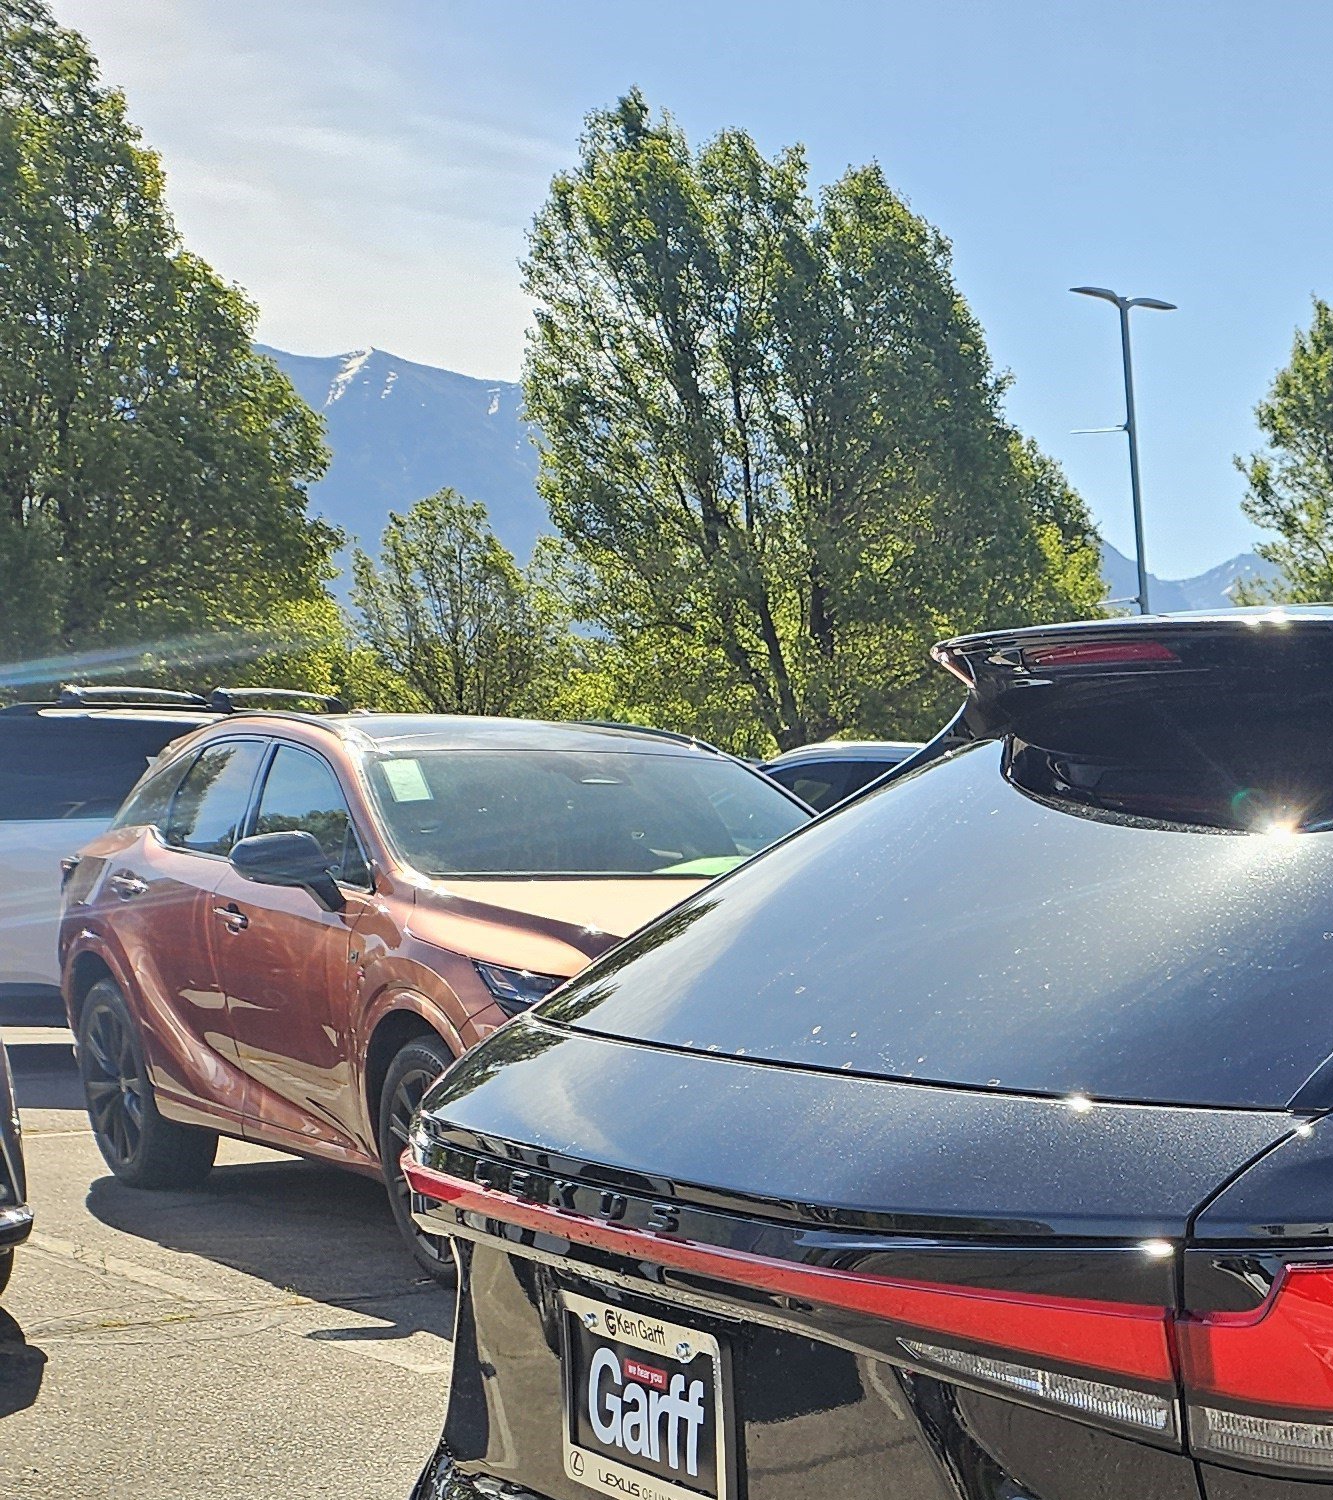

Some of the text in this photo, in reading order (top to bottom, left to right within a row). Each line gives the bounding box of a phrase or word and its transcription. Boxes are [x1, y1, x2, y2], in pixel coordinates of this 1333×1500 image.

[616, 1312, 666, 1346] Ken Garff
[650, 1372, 663, 1384] you
[589, 1347, 704, 1477] Garff
[598, 1468, 641, 1498] LEXUS
